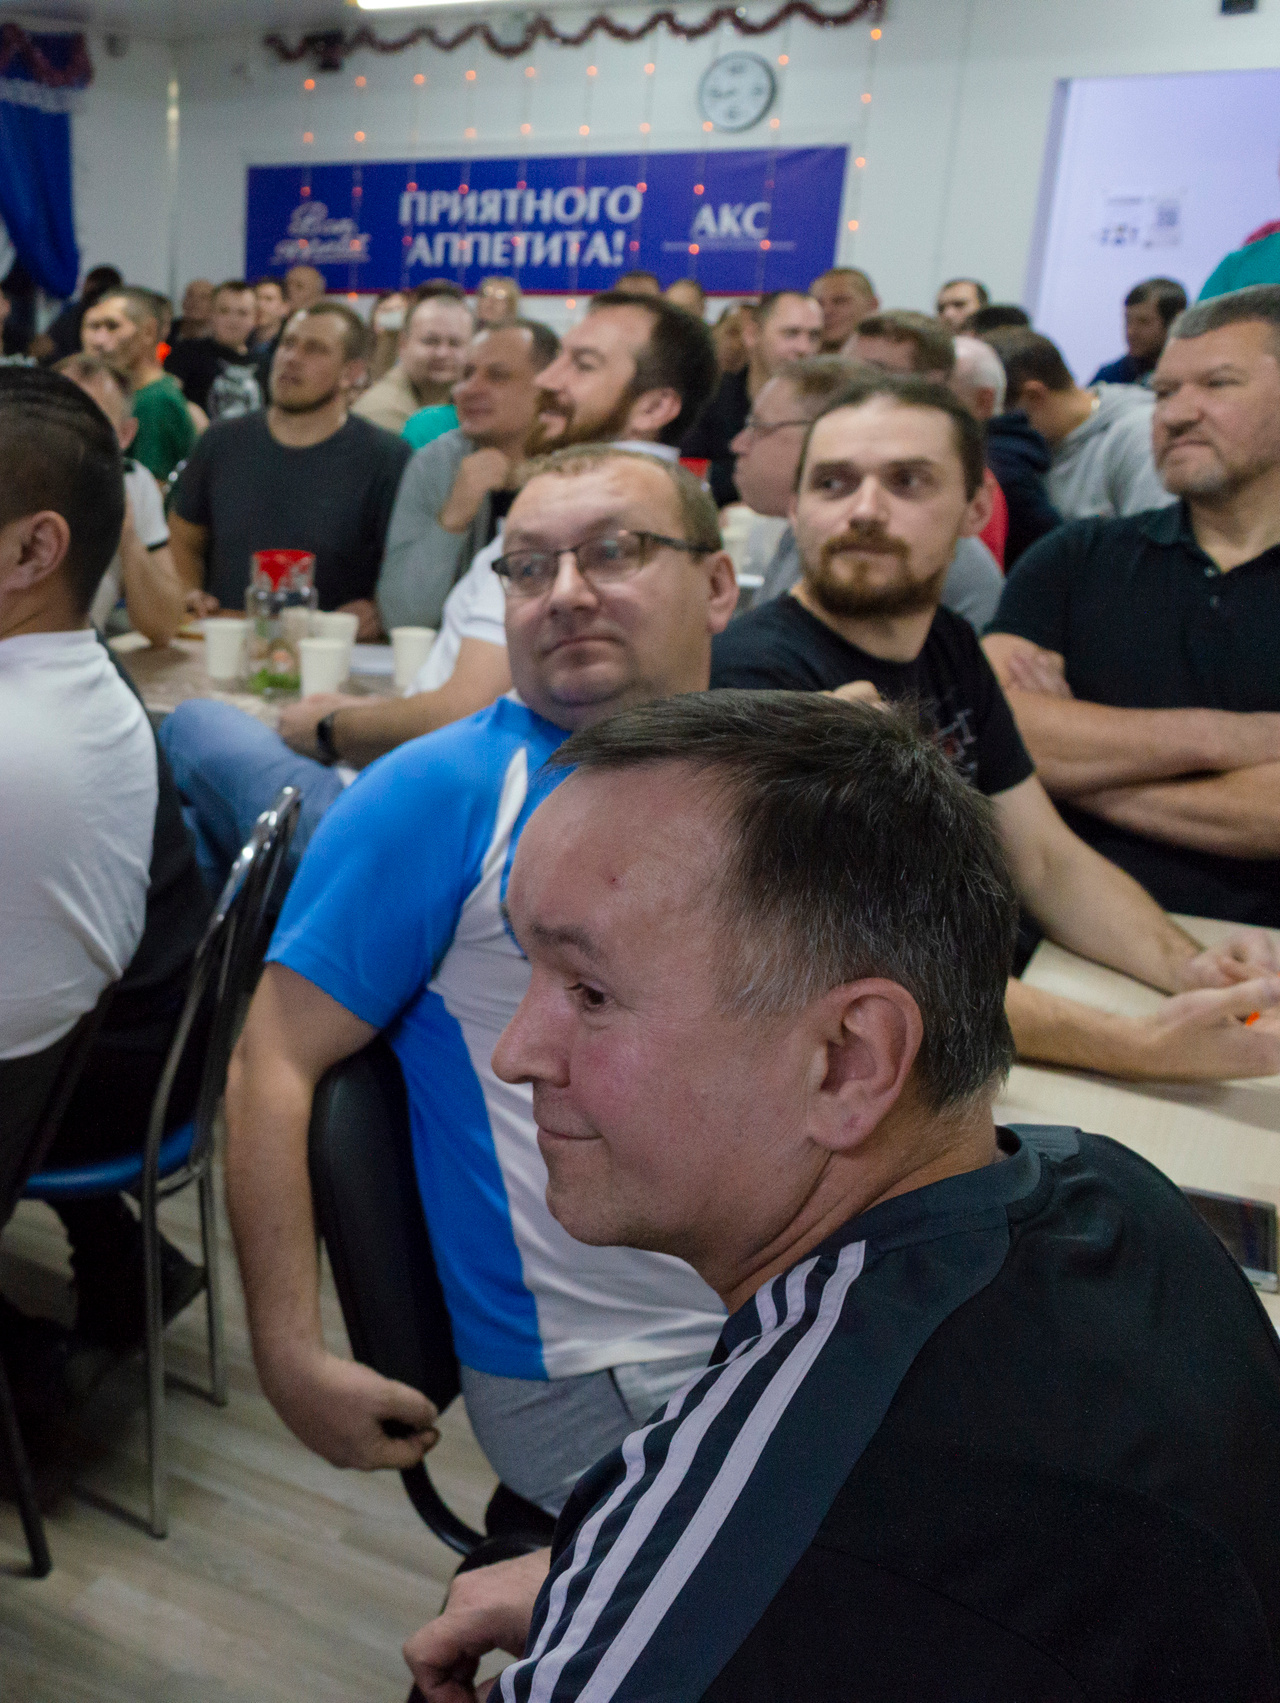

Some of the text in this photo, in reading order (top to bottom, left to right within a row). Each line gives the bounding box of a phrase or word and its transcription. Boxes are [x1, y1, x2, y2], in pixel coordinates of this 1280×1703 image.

[398, 185, 643, 226] ПРИЯТНОГО
[690, 202, 771, 238] АКС
[407, 230, 625, 267] АППЕТИТА!
